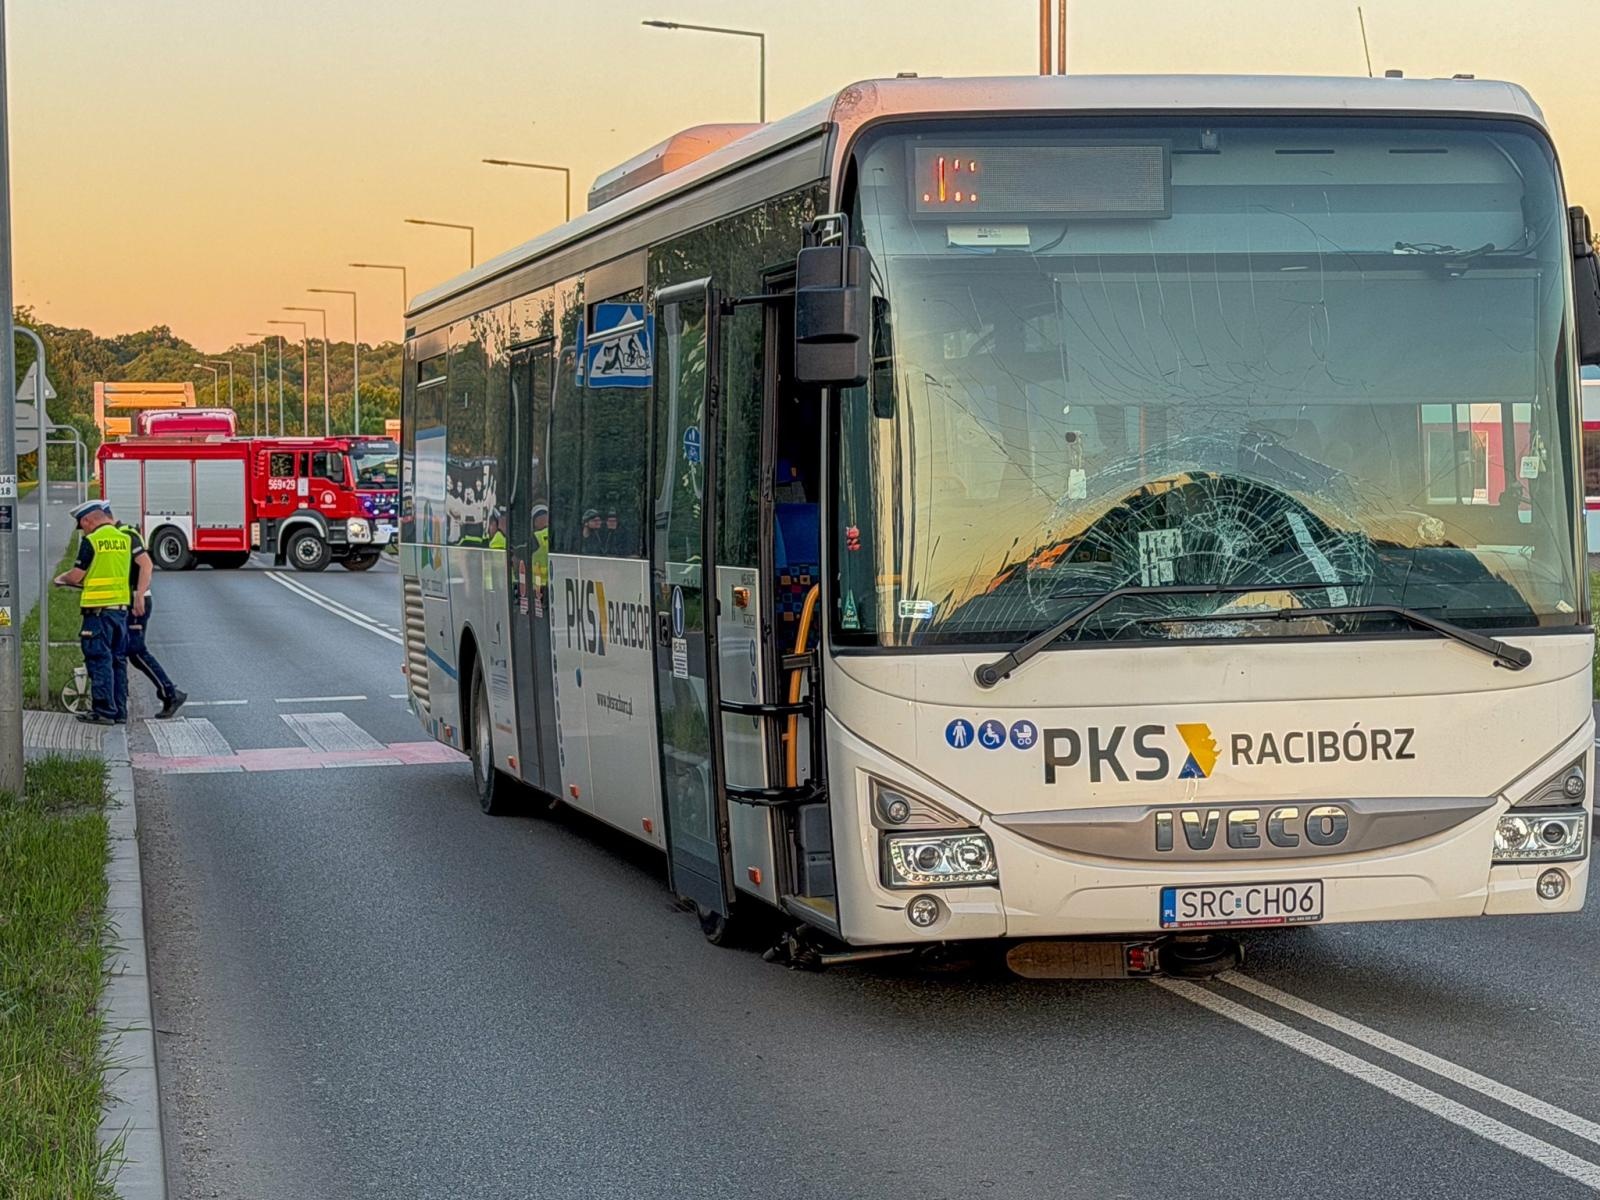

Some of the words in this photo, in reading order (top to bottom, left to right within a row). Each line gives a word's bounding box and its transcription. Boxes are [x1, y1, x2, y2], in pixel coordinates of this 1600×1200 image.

[98, 539, 127, 551] POLICJA
[565, 578, 597, 654] PKS
[608, 592, 652, 651] RACIBÓR
[1043, 724, 1170, 784] PKS
[1231, 722, 1416, 766] RACIBÓRZ
[1156, 805, 1349, 851] IVECO
[1164, 909, 1175, 918] PL
[1182, 890, 1235, 918] SRC
[1246, 885, 1314, 916] CH06
